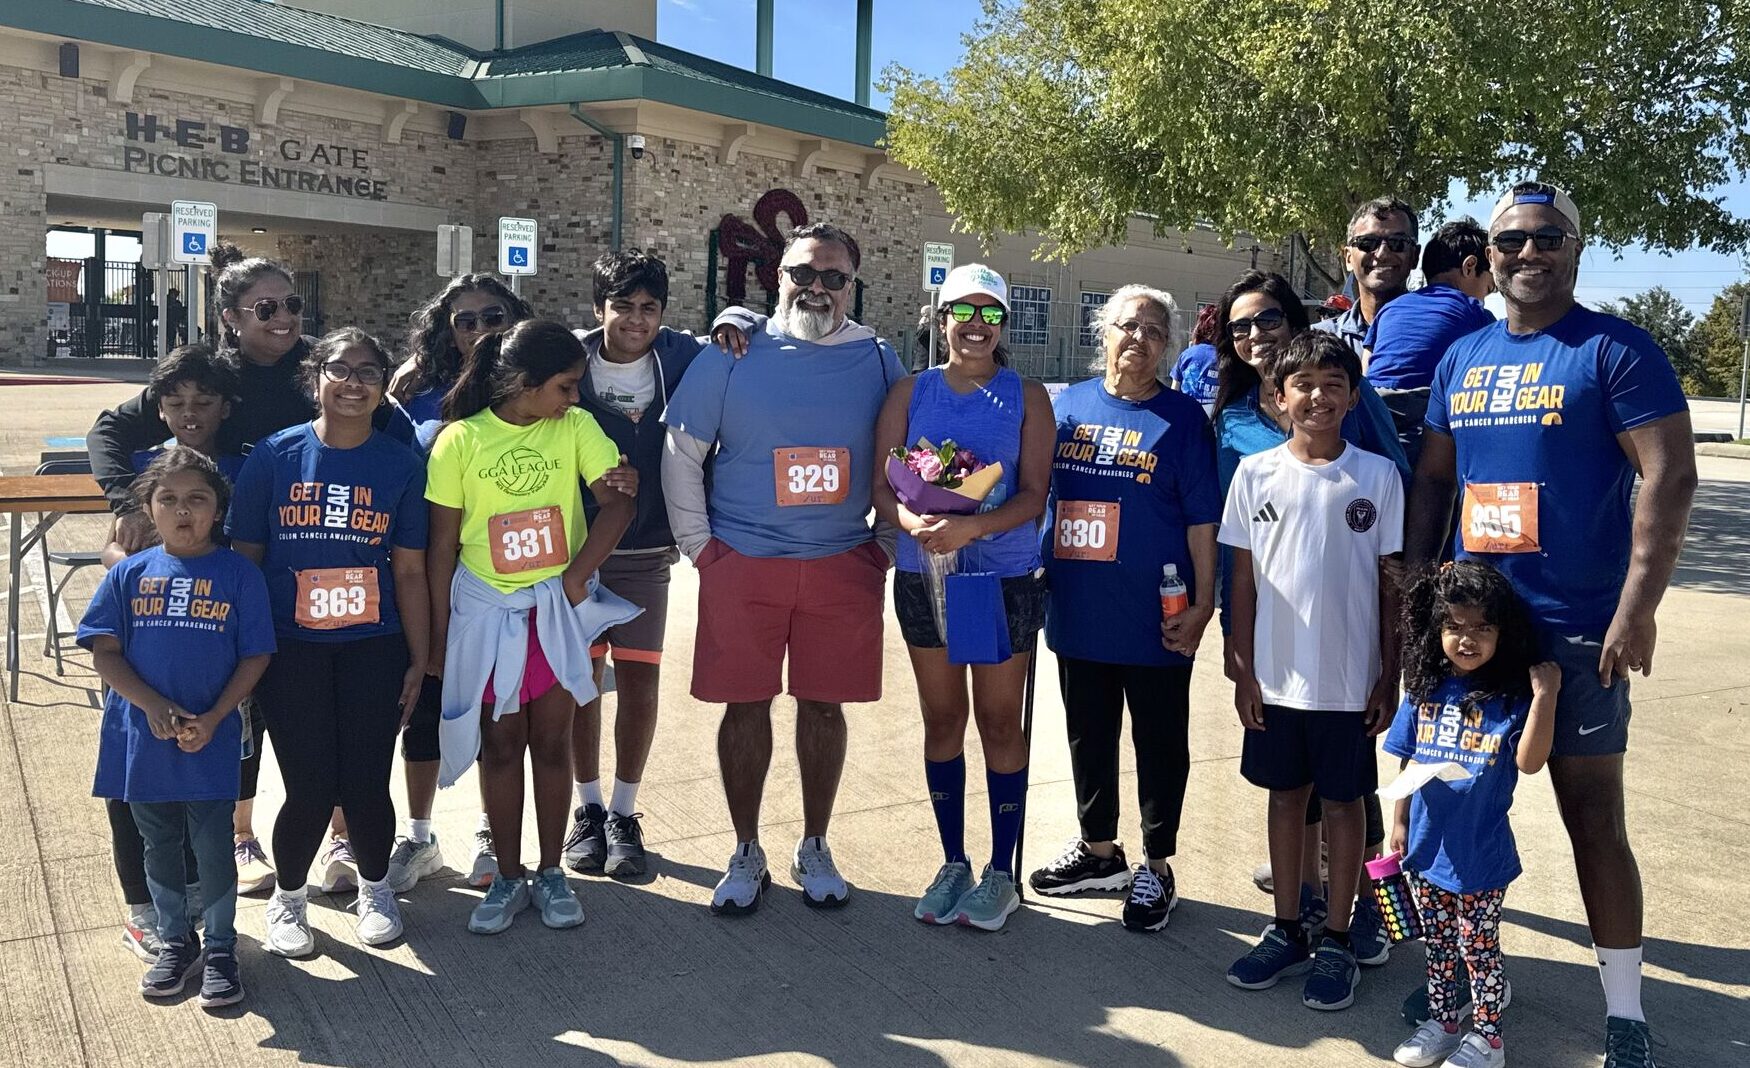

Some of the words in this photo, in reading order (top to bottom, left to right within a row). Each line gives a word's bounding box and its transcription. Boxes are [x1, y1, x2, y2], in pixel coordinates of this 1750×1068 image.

[126, 112, 250, 154] H-E-B
[280, 140, 369, 170] GATE
[124, 146, 230, 182] PICNIC
[240, 160, 388, 201] ENTRANCE
[175, 206, 214, 217] RESERVED
[177, 217, 212, 228] PARKING
[502, 223, 535, 233] RESERVED
[504, 232, 532, 242] PARKING
[46, 269, 73, 278] CK-UP
[1462, 364, 1498, 389] GET
[1520, 362, 1544, 384] IN
[1489, 364, 1523, 413] REAR
[1515, 384, 1565, 411] GEAR
[1450, 390, 1489, 416] YOUR
[1464, 417, 1492, 427] CANCER
[1494, 415, 1538, 426] AWARENESS
[1072, 423, 1103, 442] GET
[1122, 429, 1143, 447] IN
[1056, 442, 1096, 463] YOUR
[1095, 426, 1124, 465] REAR
[511, 458, 563, 476] LEAGUE
[1071, 464, 1097, 475] CANCER
[1098, 469, 1135, 479] AWARENESS
[1116, 448, 1158, 473] GEAR
[788, 464, 840, 494] 329
[289, 482, 324, 502] GET
[353, 486, 372, 506] IN
[278, 504, 321, 527] YOUR
[324, 483, 351, 529] REAR
[350, 508, 390, 534] GEAR
[279, 532, 297, 540] COLON
[300, 532, 327, 540] CANCER
[502, 525, 554, 561] 331
[1061, 518, 1107, 549] 330
[139, 576, 170, 594] GET
[193, 578, 212, 596] IN
[131, 597, 165, 616] YOUR
[167, 577, 193, 617] REAR
[309, 586, 366, 619] 363
[190, 599, 230, 621] GEAR
[174, 621, 216, 631] AWARENESS
[1416, 723, 1436, 744] UR
[1437, 703, 1462, 748] REAR
[1460, 729, 1502, 754] GEAR
